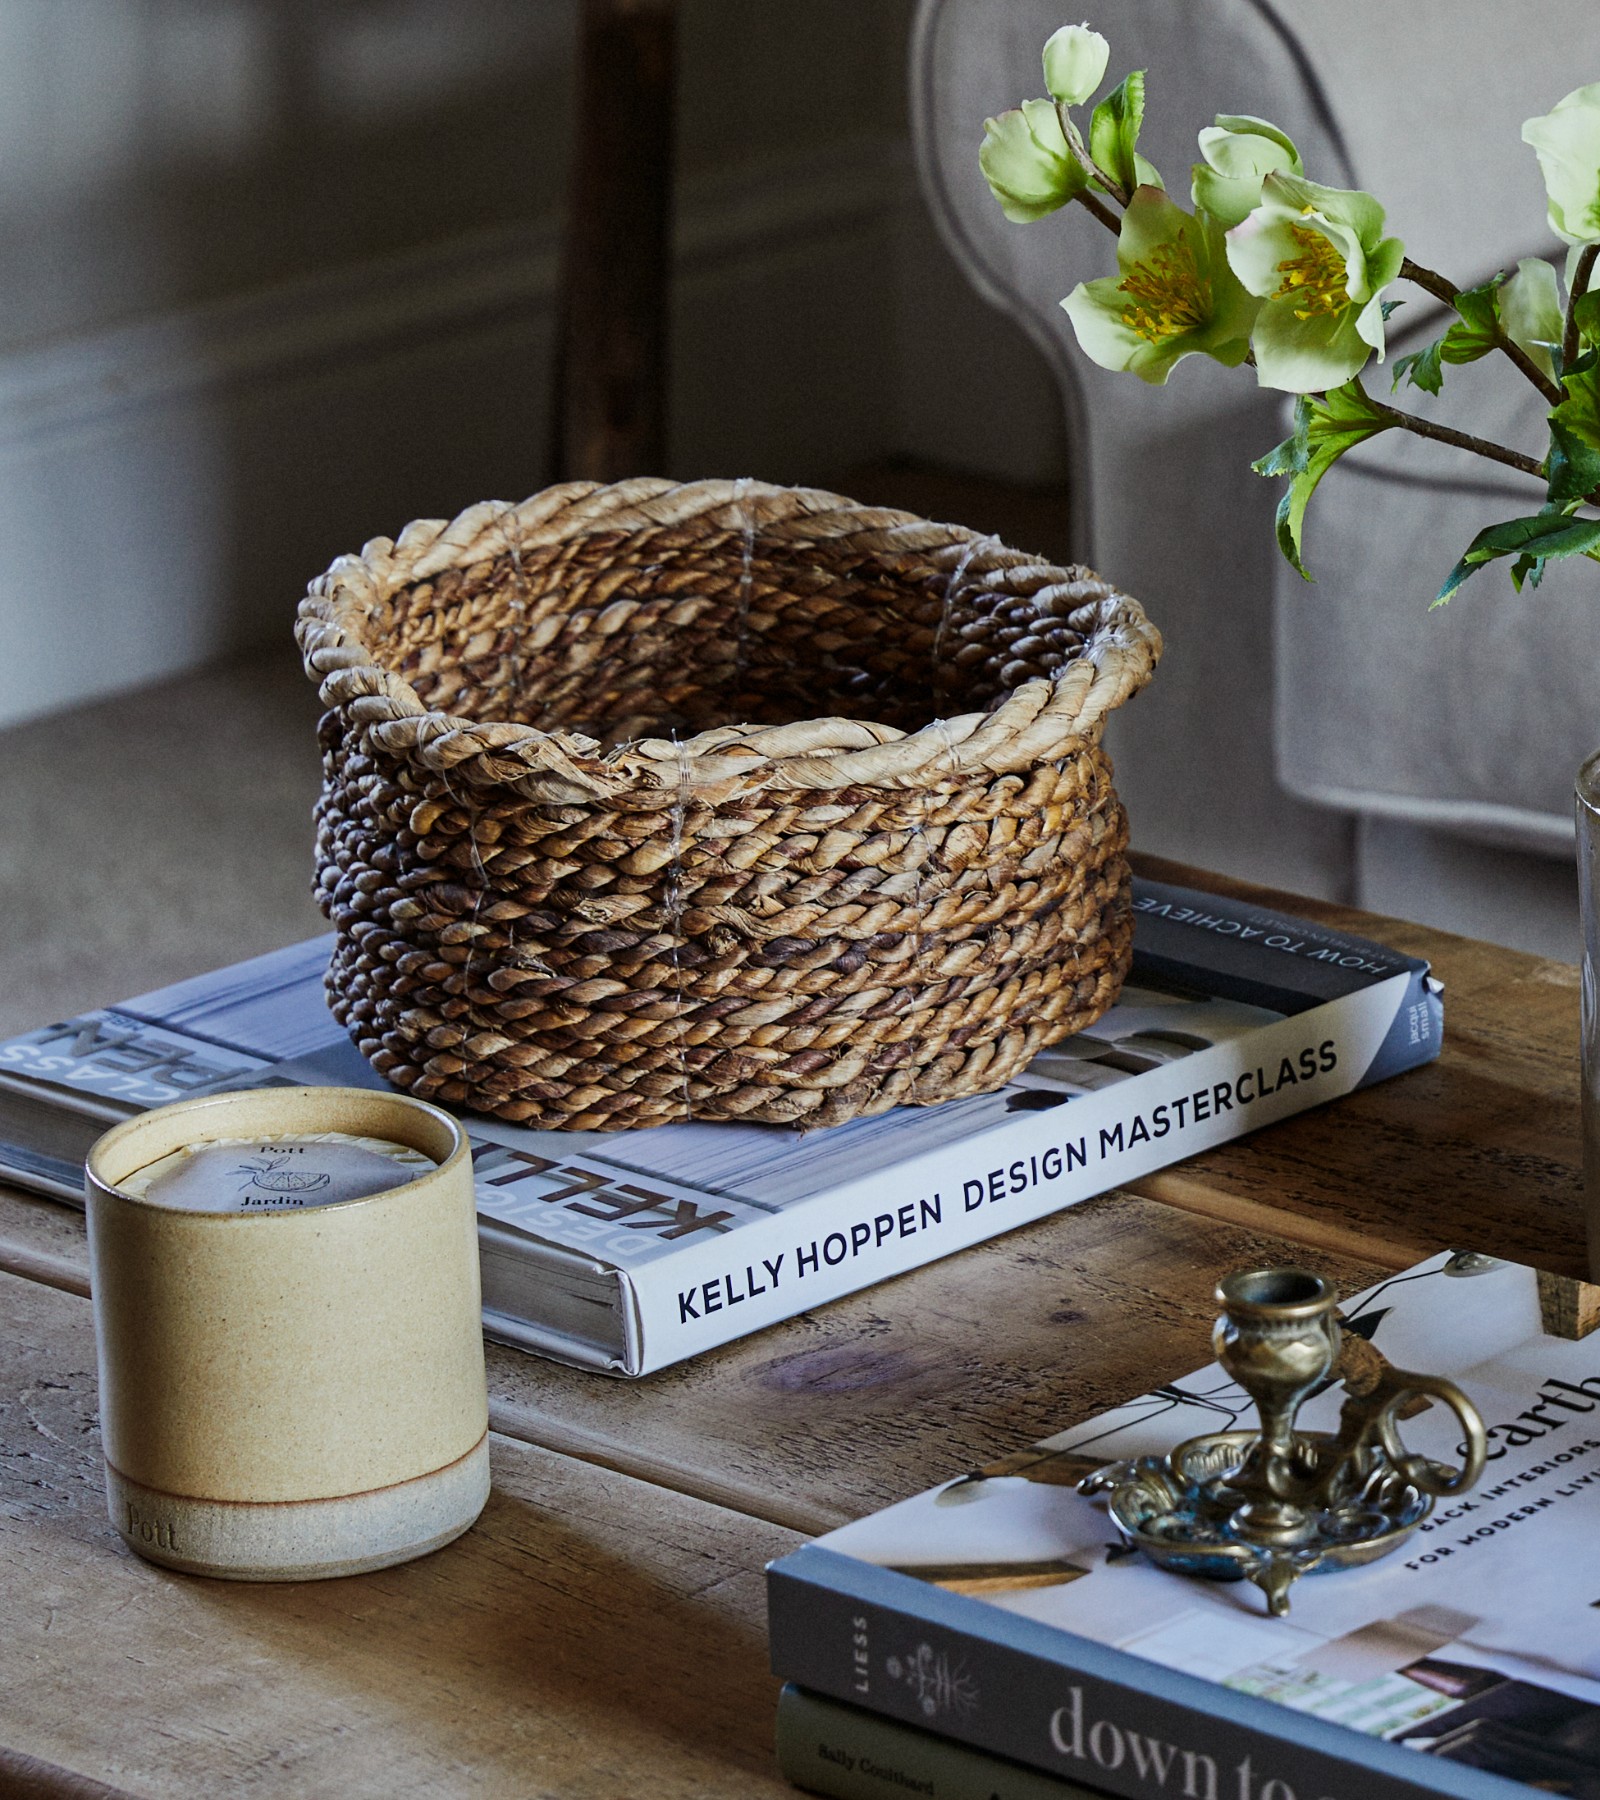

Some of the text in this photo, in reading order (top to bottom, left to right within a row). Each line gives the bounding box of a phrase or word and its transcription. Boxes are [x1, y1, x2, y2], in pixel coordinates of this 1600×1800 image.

[1131, 897, 1388, 974] HOW TO ACHIEVE
[1408, 1005, 1420, 1044] jacqui
[1418, 1001, 1430, 1040] small
[260, 1146, 305, 1154] Pott
[678, 1040, 1338, 1324] KELLY HOPPEN DESIGN MASTERCLASS
[241, 1196, 304, 1206] Jardin
[474, 1183, 663, 1257] DESIG
[126, 1501, 180, 1551] Pott
[1404, 1547, 1455, 1571] FOR
[1458, 1497, 1555, 1546] MODERN
[853, 1615, 870, 1693] LIESS
[1050, 1686, 1218, 1800] down
